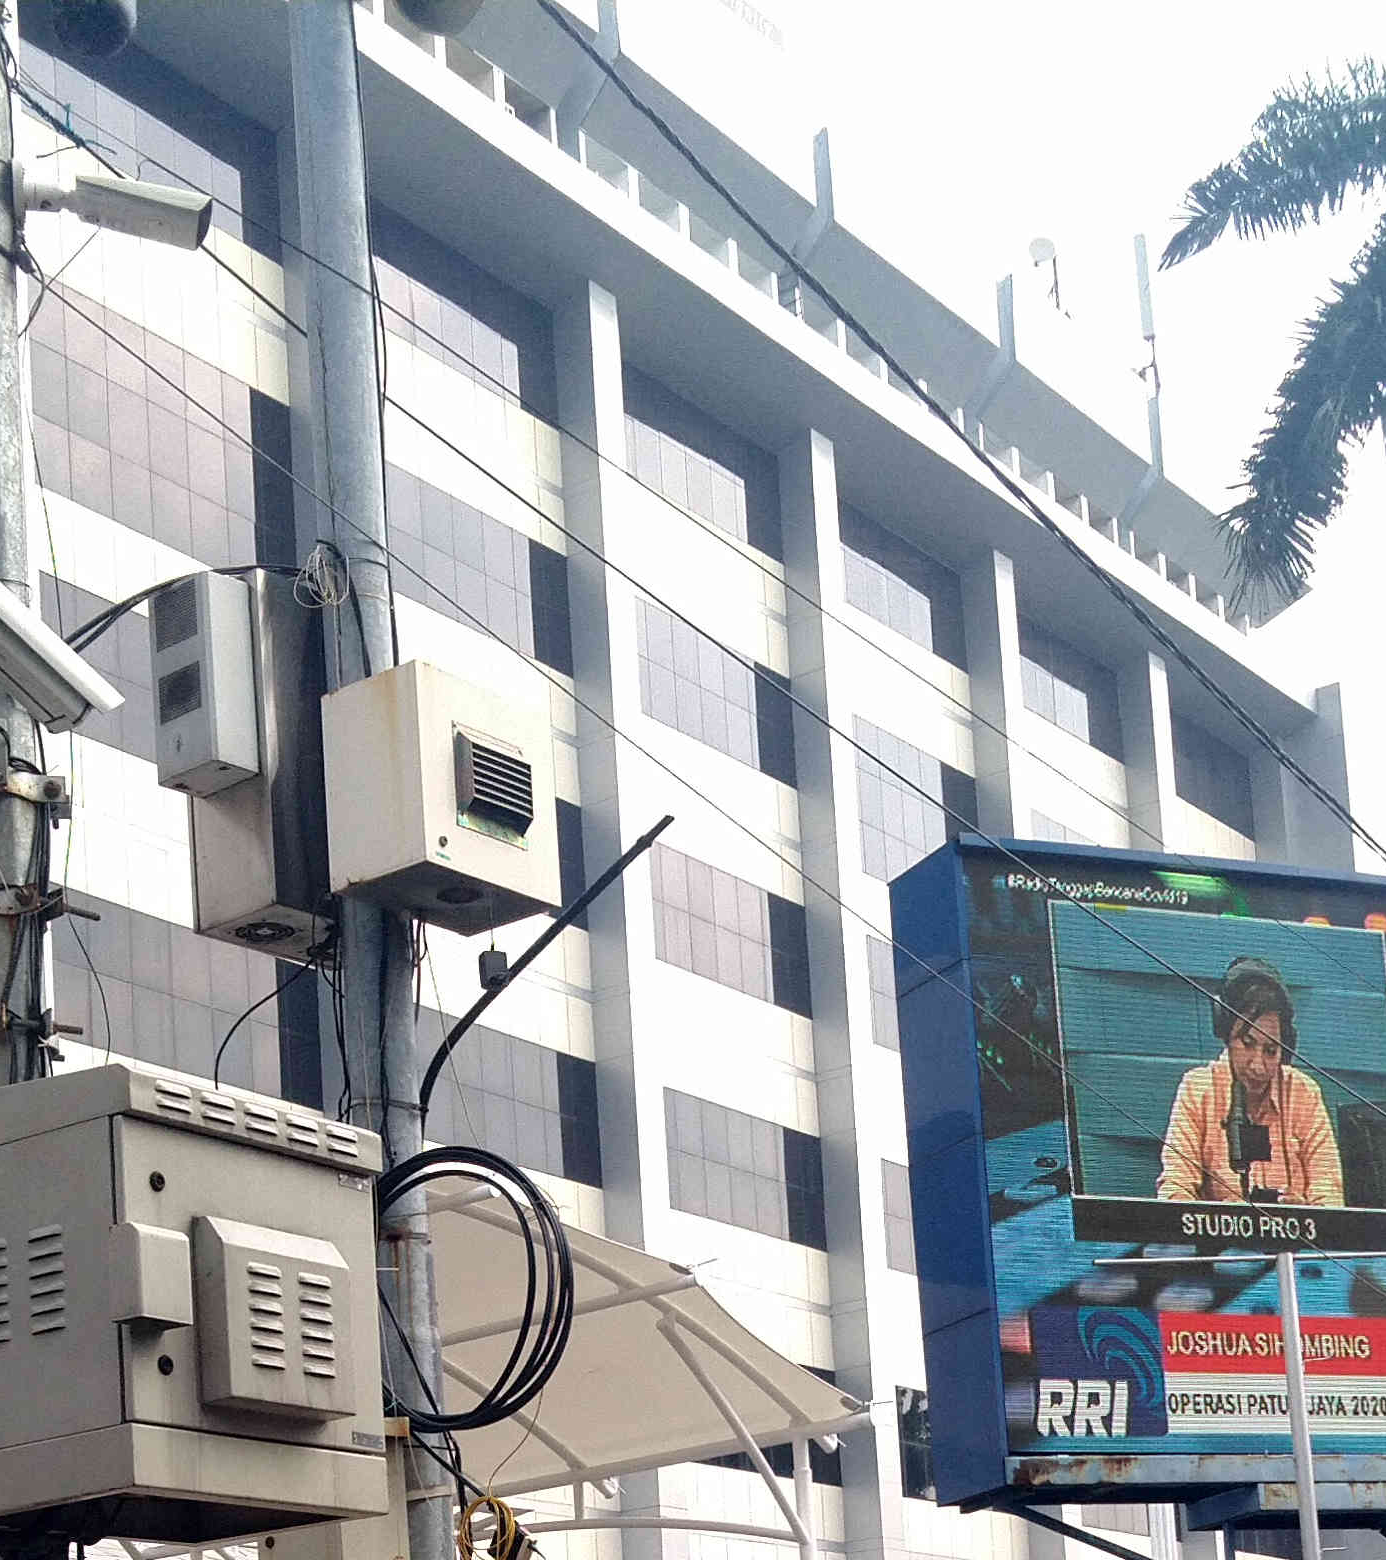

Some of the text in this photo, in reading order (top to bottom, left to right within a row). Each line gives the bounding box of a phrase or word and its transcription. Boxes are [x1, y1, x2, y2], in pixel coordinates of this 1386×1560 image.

[1182, 1213, 1317, 1240] STUDIO PRO 3
[1167, 1331, 1252, 1357] JOSHUA
[1036, 1379, 1128, 1437] RRI
[1168, 1394, 1243, 1416] OPERASI
[1247, 1394, 1288, 1416] PATU
[1308, 1396, 1347, 1416] JAYA
